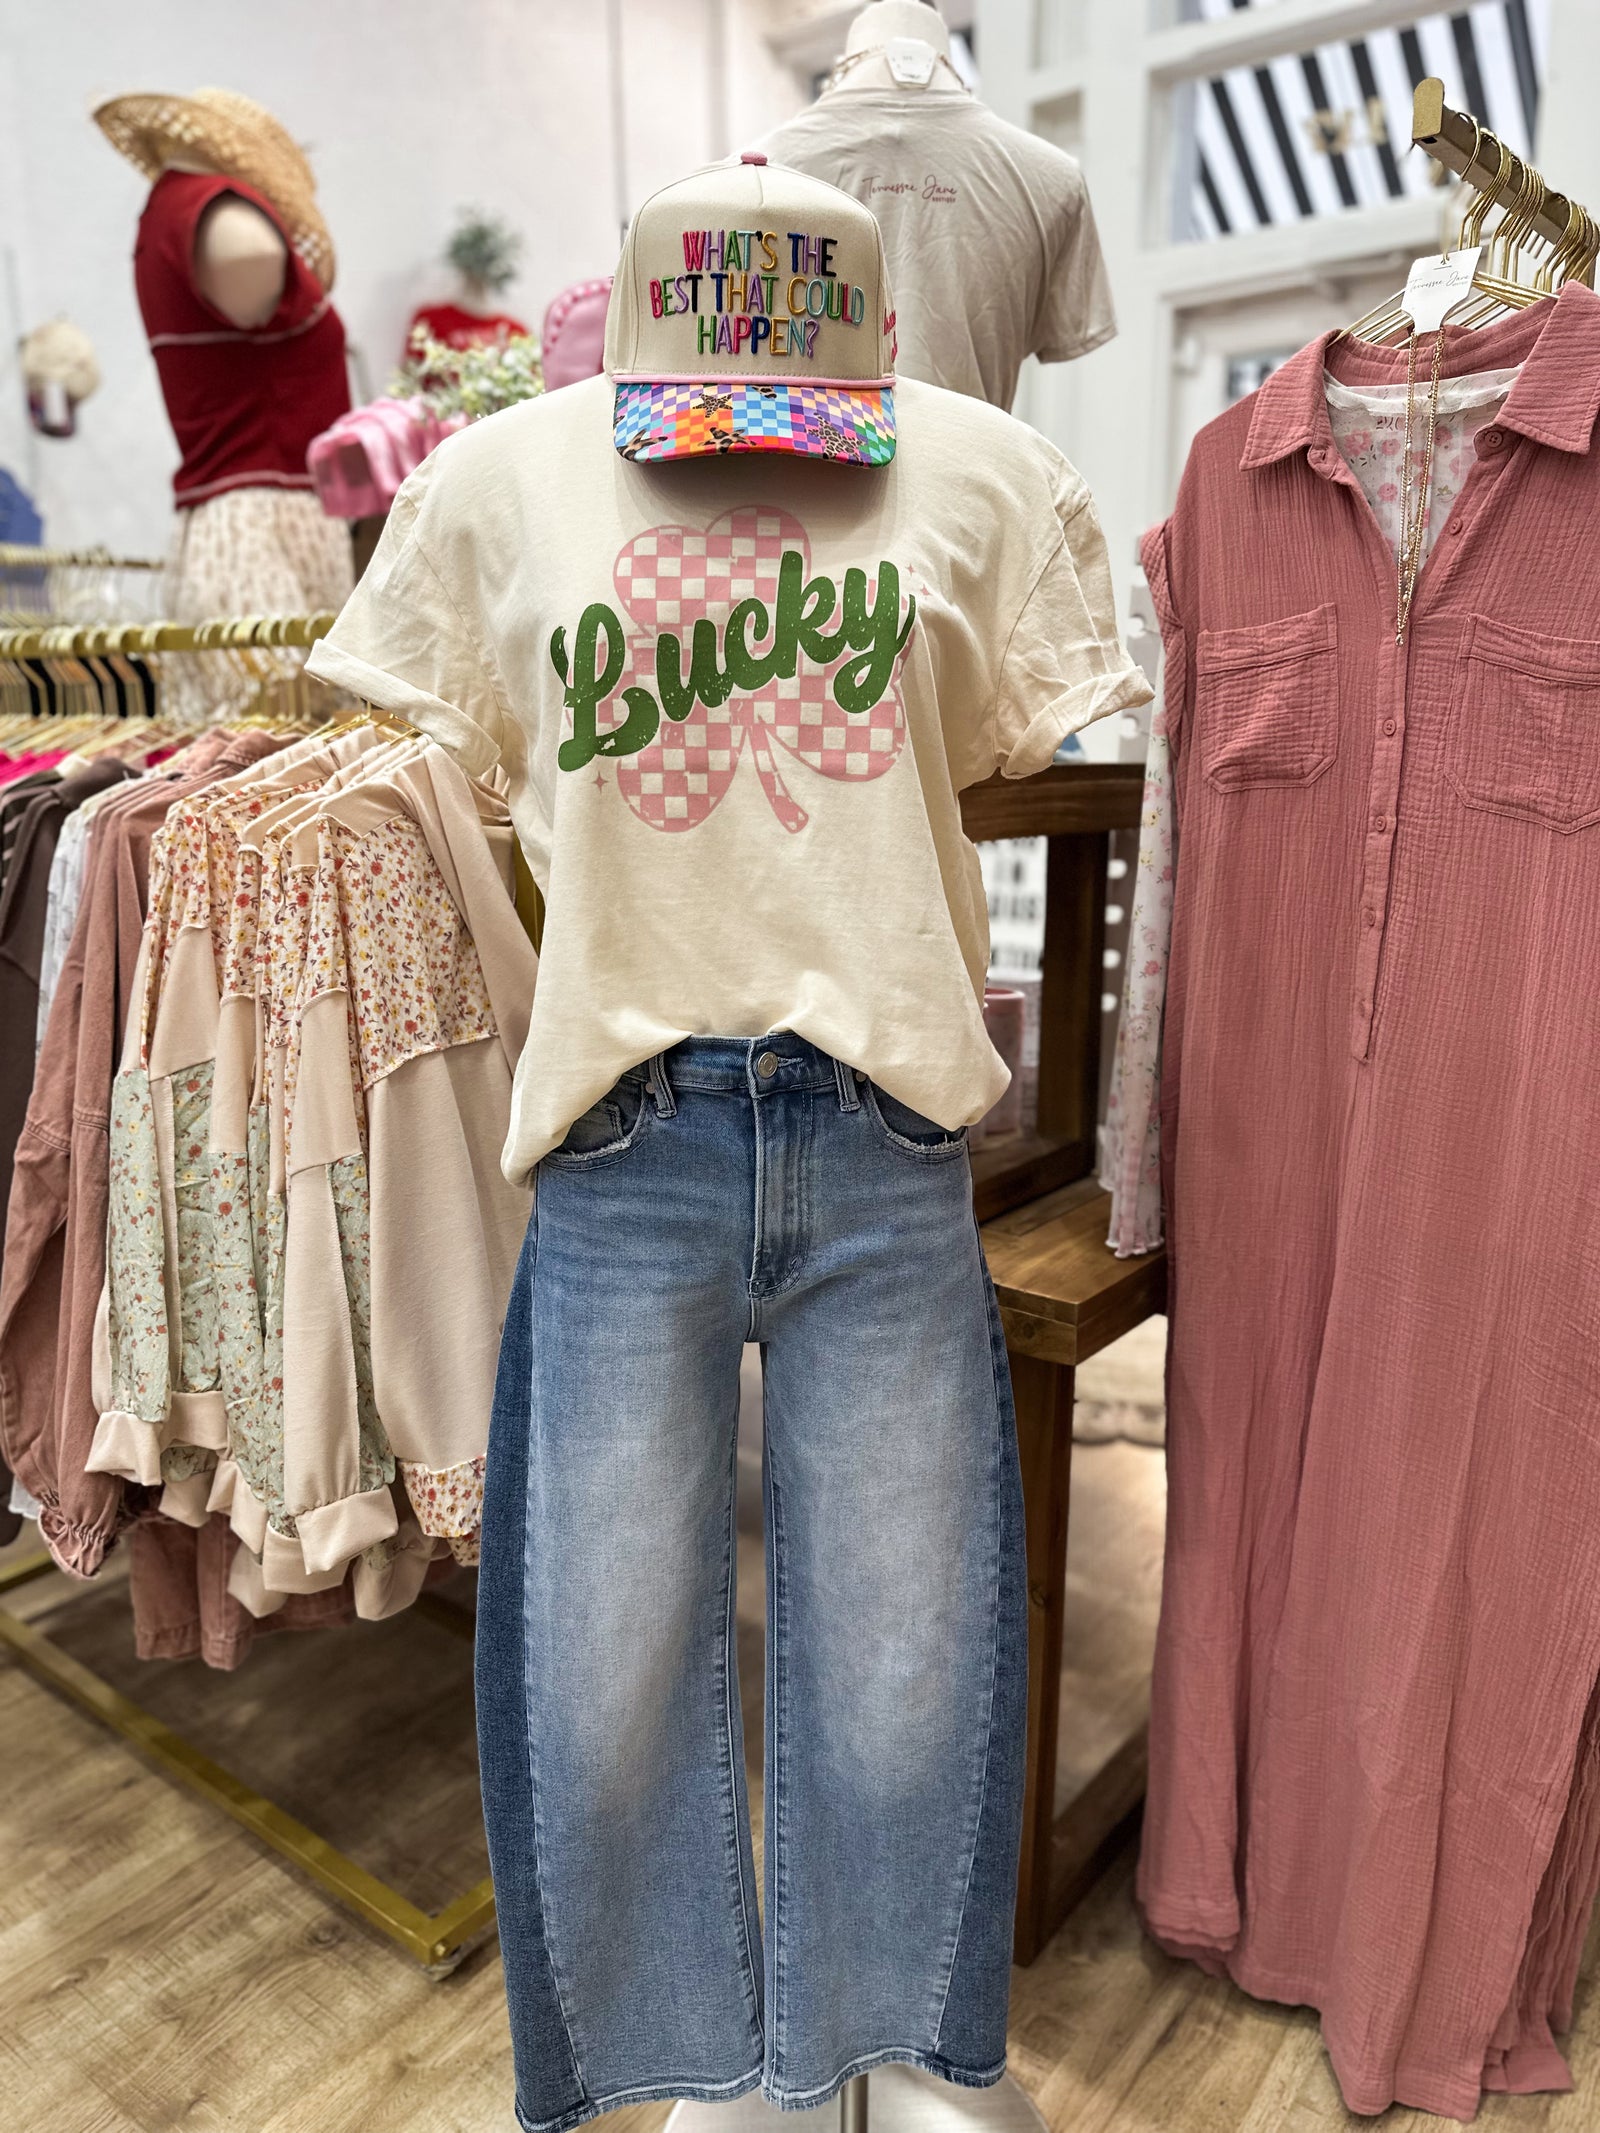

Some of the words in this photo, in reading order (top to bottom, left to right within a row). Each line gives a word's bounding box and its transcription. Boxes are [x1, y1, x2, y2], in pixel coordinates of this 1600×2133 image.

[862, 175, 917, 199] Tennessee
[922, 174, 957, 199] Jane
[683, 229, 777, 271] WHAT'S
[787, 232, 838, 277] THE
[650, 273, 703, 318] BEST
[710, 272, 780, 314] THAT
[787, 276, 865, 326] COULD
[697, 315, 820, 358] HAPPEN?
[550, 550, 916, 772] Lucky
